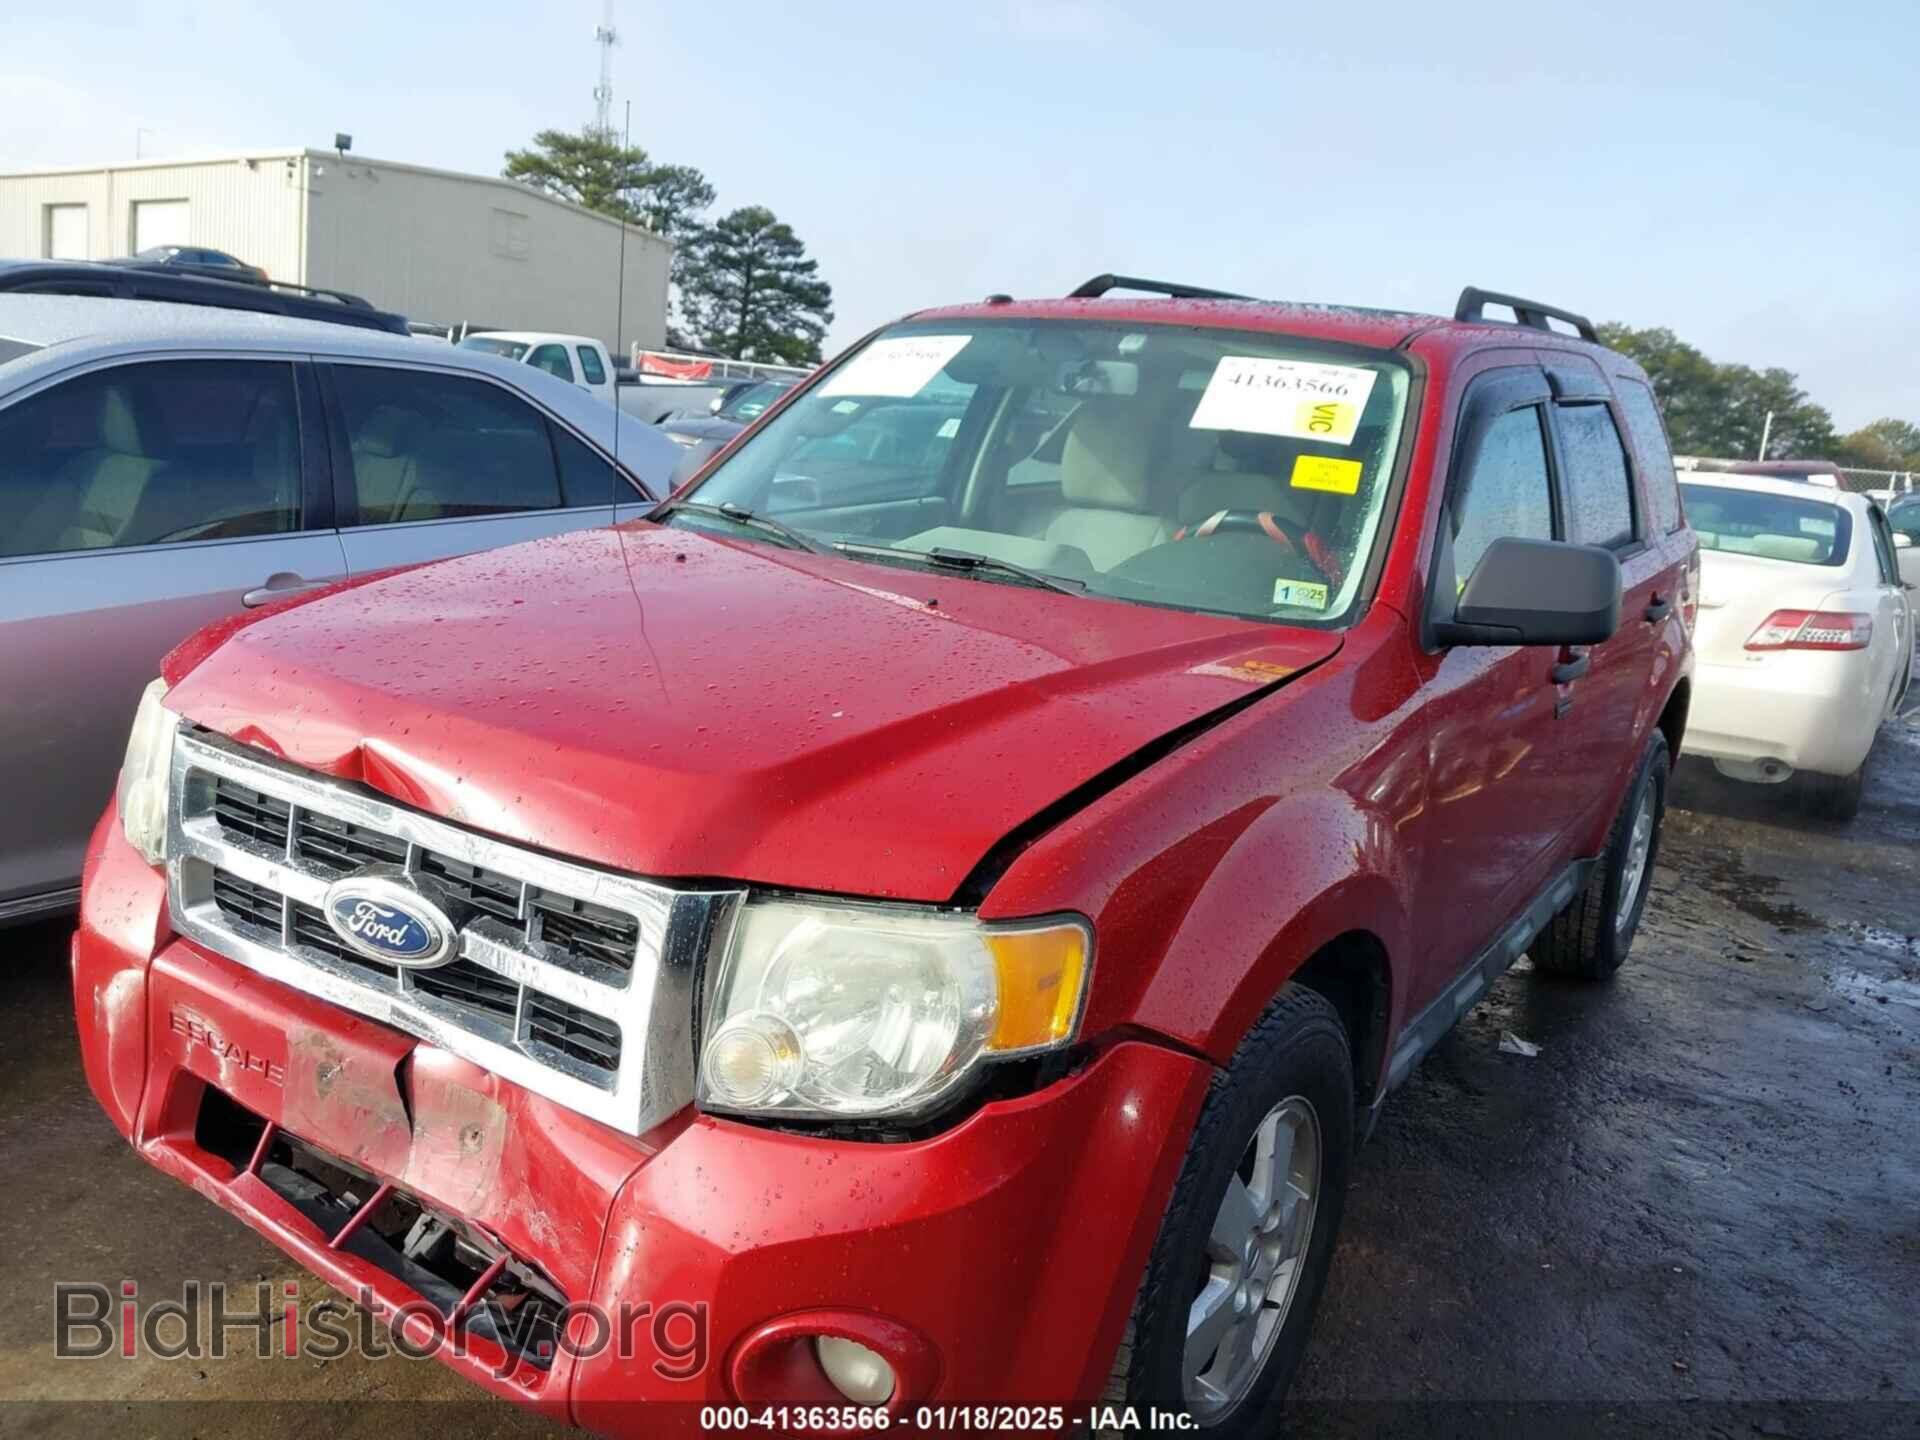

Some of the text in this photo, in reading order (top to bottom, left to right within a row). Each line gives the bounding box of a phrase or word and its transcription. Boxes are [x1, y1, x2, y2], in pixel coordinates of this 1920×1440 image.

[1228, 372, 1349, 397] 41363566
[1308, 403, 1339, 433] VIC
[348, 900, 409, 947] Ford
[168, 1008, 285, 1087] ESCAPE
